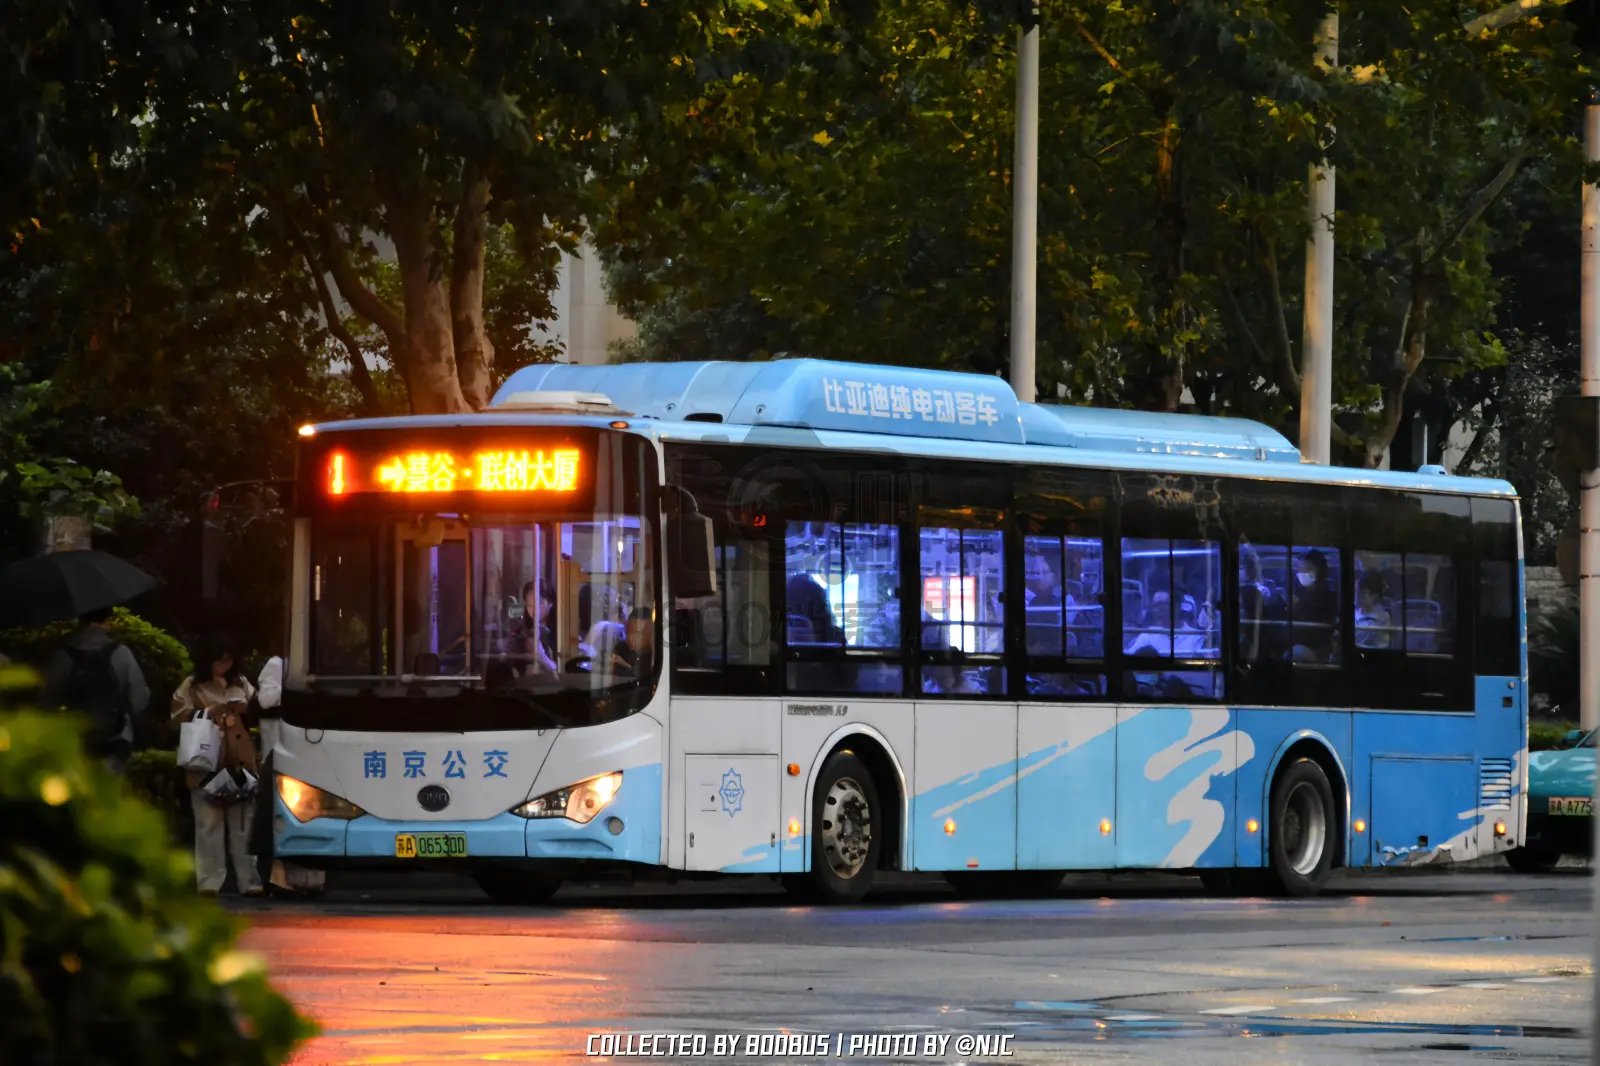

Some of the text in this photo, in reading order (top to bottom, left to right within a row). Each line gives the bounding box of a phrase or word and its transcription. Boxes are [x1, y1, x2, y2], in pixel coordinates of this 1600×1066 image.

[823, 377, 999, 426] 比亚迪纯电动客车
[329, 453, 345, 495] 1
[364, 750, 509, 779] 南京公交
